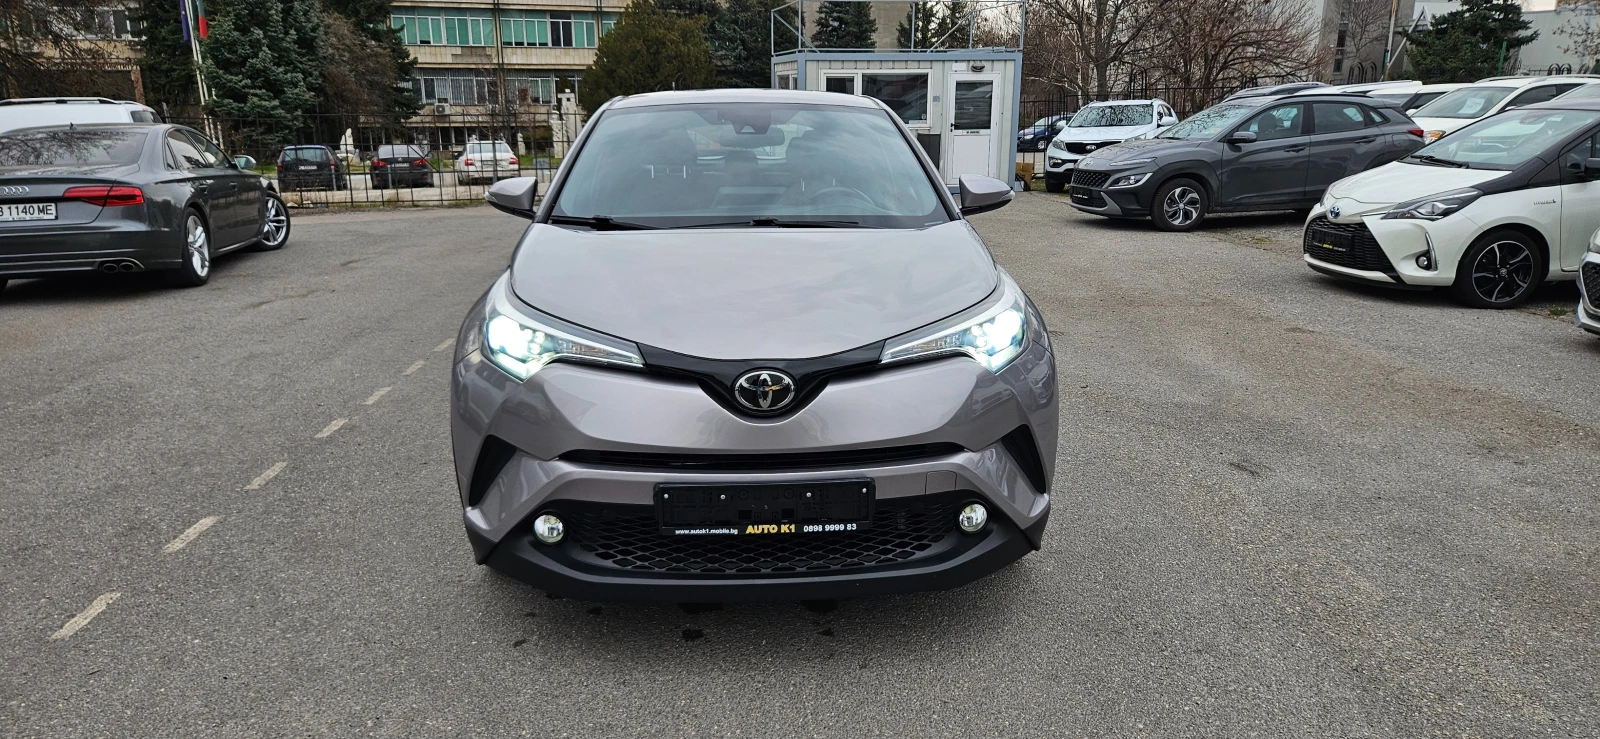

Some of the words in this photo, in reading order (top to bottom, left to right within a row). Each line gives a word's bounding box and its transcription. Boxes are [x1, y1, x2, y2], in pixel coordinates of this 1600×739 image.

[8, 205, 35, 216] 1140
[37, 204, 53, 215] ME
[746, 525, 778, 534] AUTO
[780, 523, 796, 533] K1
